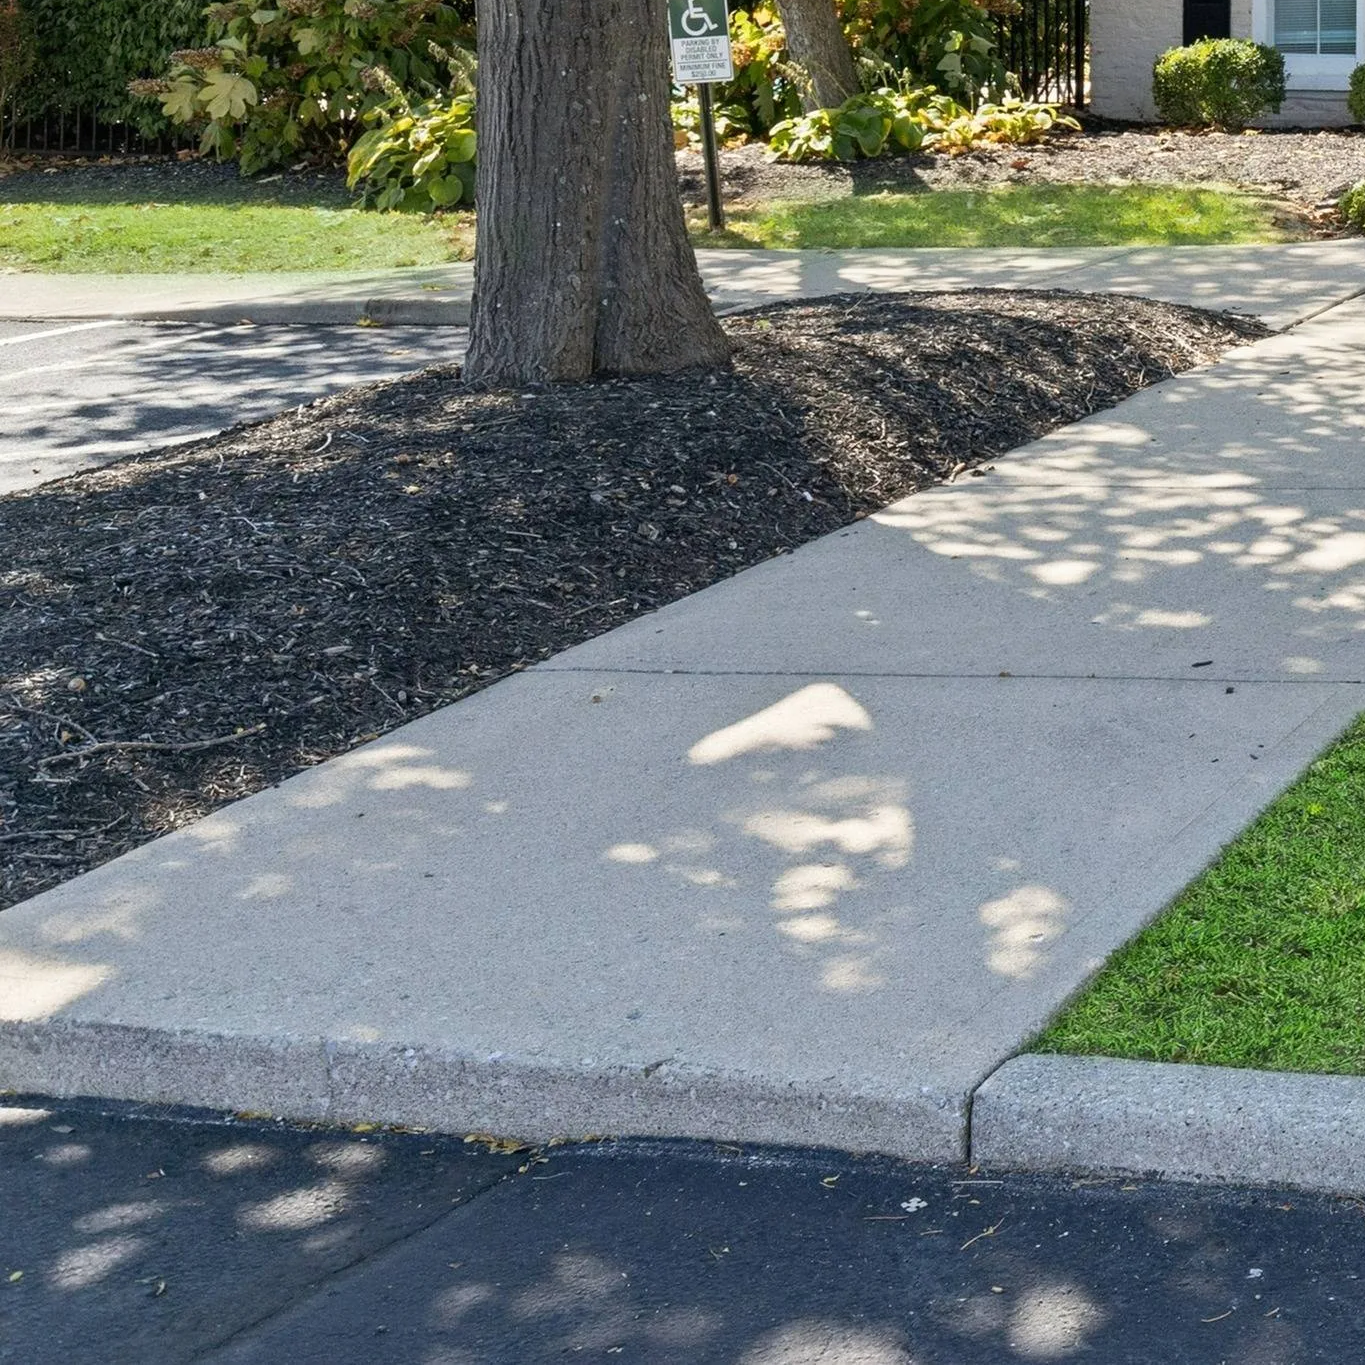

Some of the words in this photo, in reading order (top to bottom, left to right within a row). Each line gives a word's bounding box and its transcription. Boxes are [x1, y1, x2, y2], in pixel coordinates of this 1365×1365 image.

[681, 39, 709, 47] PARKING
[685, 45, 717, 54] DISABLED
[680, 53, 704, 61] PERMIT
[706, 52, 723, 60] ONLY
[711, 62, 725, 70] FINE
